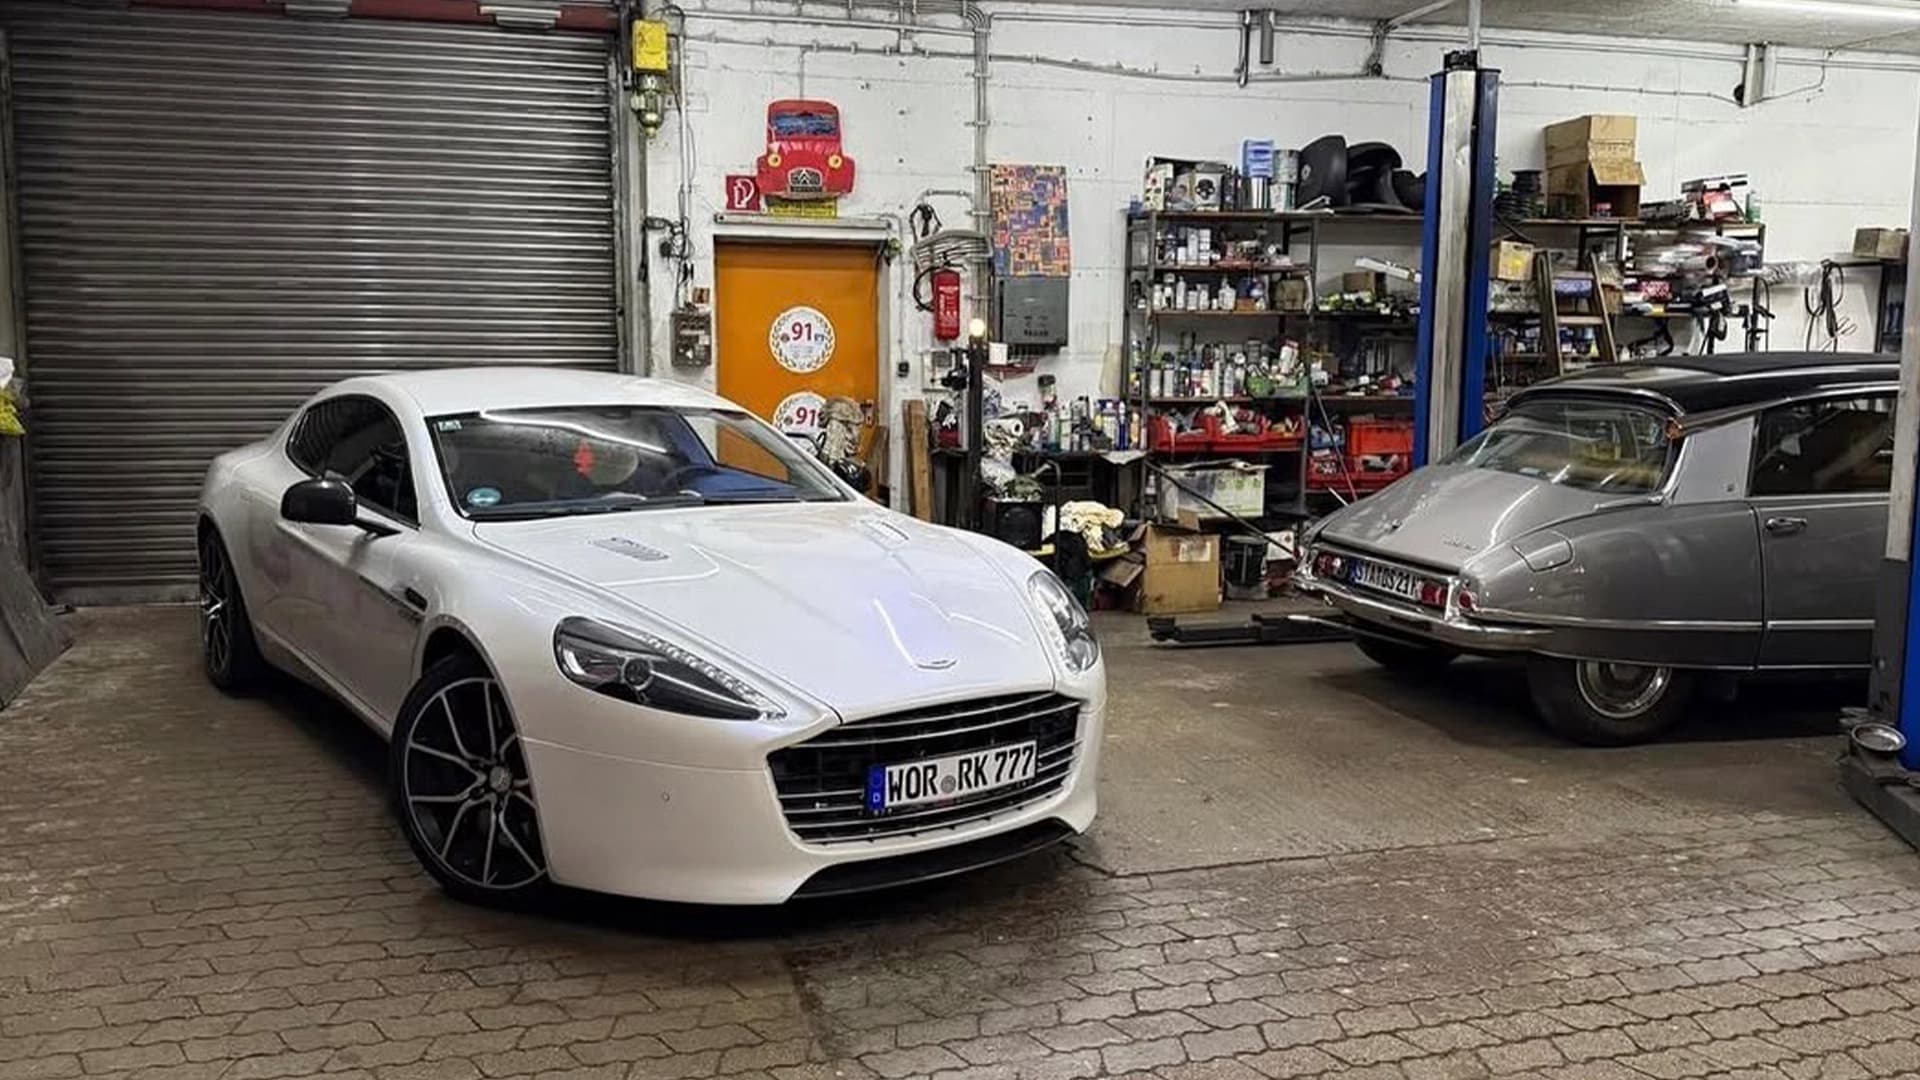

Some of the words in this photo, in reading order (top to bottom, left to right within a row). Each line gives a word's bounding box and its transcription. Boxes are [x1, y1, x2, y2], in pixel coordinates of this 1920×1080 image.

[791, 321, 812, 341] 91
[888, 764, 938, 802] WOR
[958, 754, 988, 791] RK
[995, 746, 1033, 783] 777
